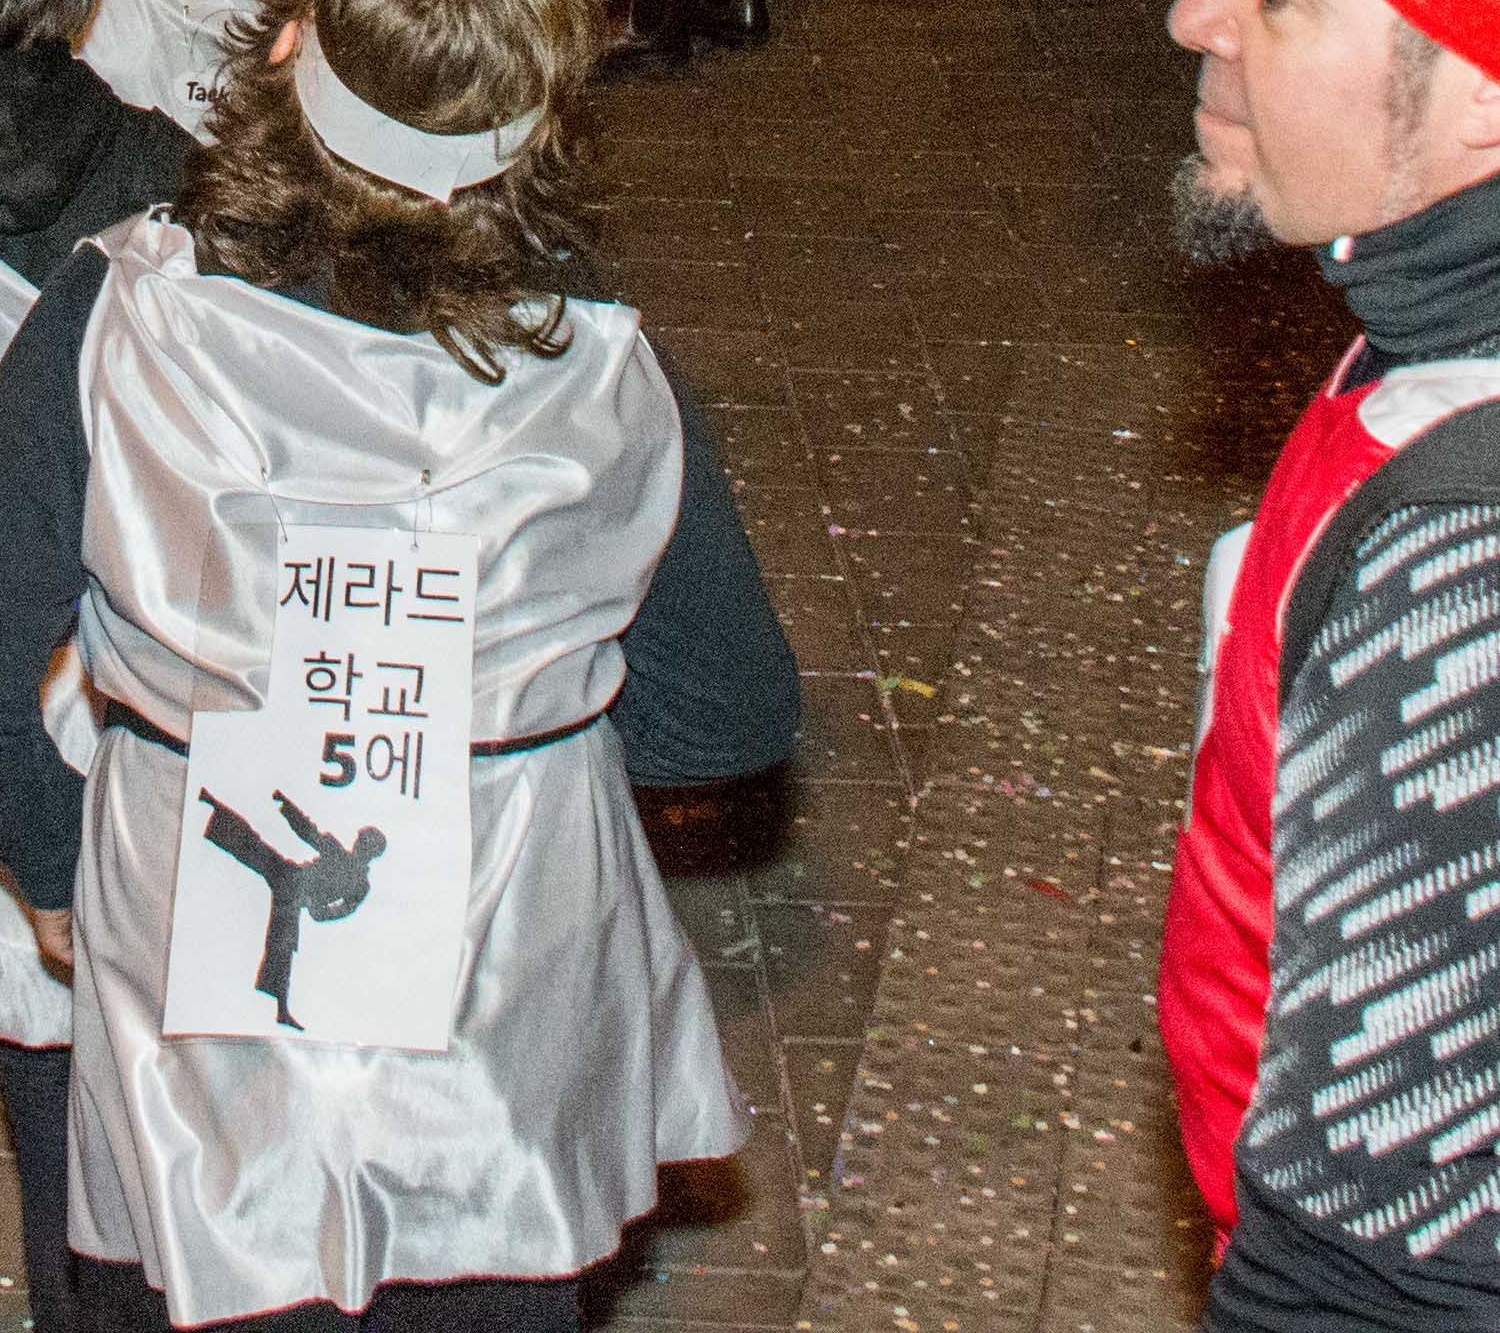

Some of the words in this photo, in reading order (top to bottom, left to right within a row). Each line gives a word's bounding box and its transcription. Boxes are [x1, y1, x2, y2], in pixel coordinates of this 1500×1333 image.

[280, 556, 465, 626] 제라드
[303, 650, 430, 722] 학교
[318, 731, 424, 800] 5에
